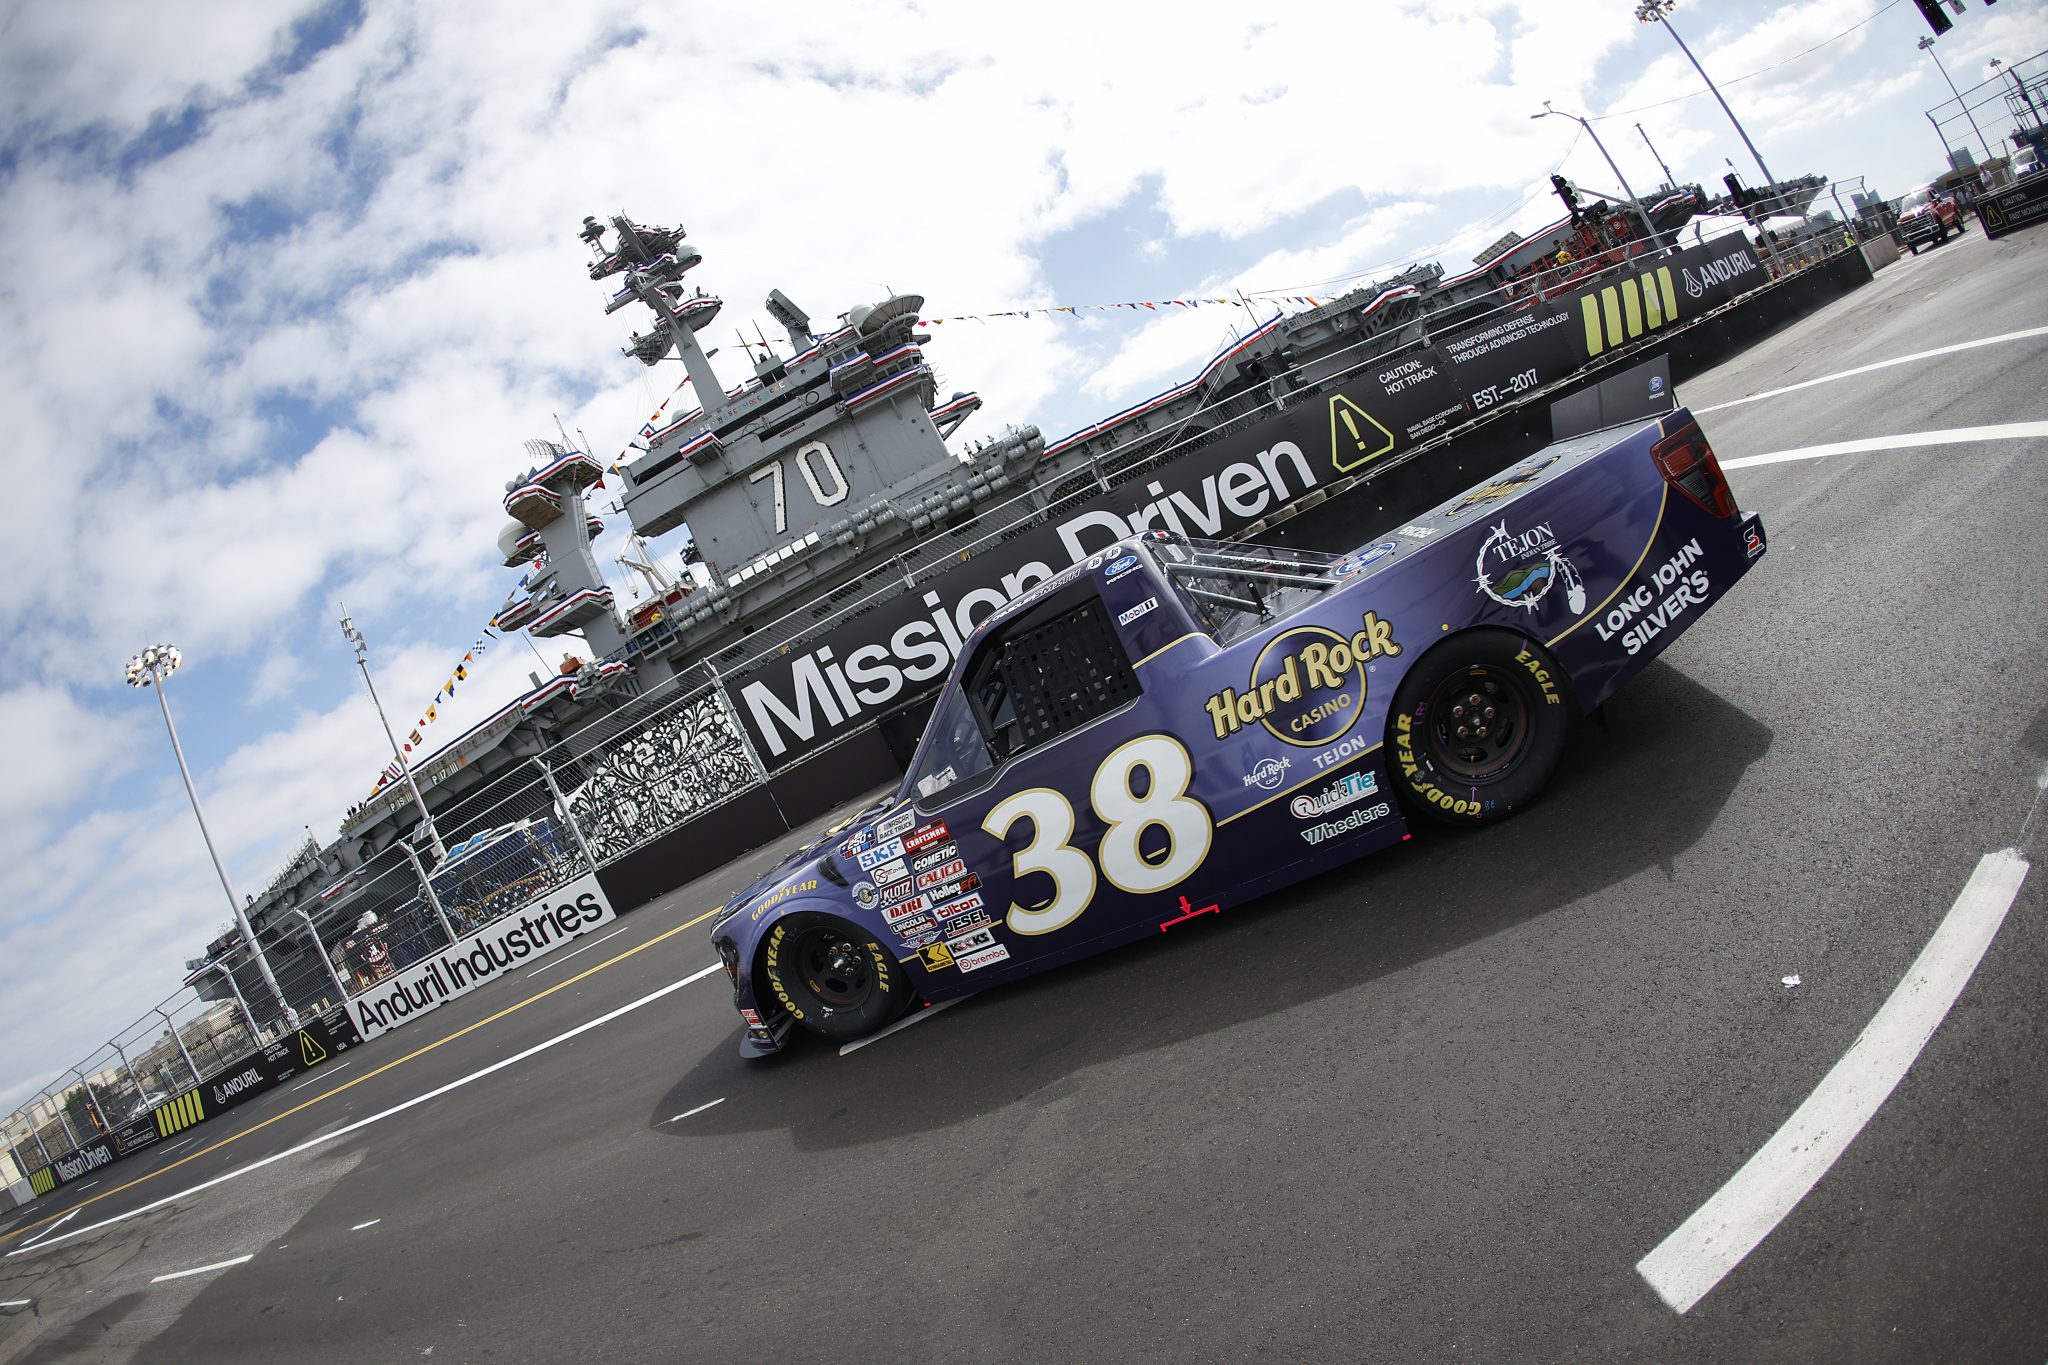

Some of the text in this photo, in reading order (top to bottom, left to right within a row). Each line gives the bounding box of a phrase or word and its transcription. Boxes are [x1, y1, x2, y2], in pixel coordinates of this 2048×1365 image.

[2008, 210, 2021, 221] FAST
[2021, 203, 2041, 217] MOVING
[1699, 250, 1757, 288] ANDURIL
[1446, 314, 1535, 354] TRANSFORMING DEFENSE
[1452, 312, 1569, 364] THROUGH ADVANCED TECHNOLOGY
[1379, 360, 1423, 384] CAUTION:
[1384, 366, 1438, 396] HOT TRACK
[1406, 403, 1463, 433] NAVAL BASE CORONADO
[1409, 430, 1421, 440] SAN
[749, 441, 850, 535] 70
[1492, 521, 1554, 562] TEJON
[1520, 539, 1558, 560] INDIAN TRIBE
[1106, 564, 1144, 585] RACING
[1112, 558, 1131, 573] Ford
[741, 440, 1317, 757] Mission Driven
[1594, 537, 1704, 642] LONG JOHN
[1120, 605, 1145, 624] Mobil
[1621, 570, 1710, 656] SILVER'S
[1204, 610, 1402, 740] Hard Rock
[1514, 649, 1560, 705] EAGLE
[1291, 692, 1352, 733] CASINO
[1312, 735, 1366, 769] TEJON
[1397, 713, 1481, 815] GOODYEAR
[1243, 756, 1291, 787] Hard Rock
[1265, 775, 1279, 786] CAFE
[880, 829, 895, 839] RACE
[894, 820, 913, 833] TRUCK
[887, 813, 910, 827] NASCAR
[980, 734, 1213, 935] 38
[1301, 802, 1389, 846] Wheelers
[906, 826, 946, 848] CRAFTSMAN
[861, 840, 901, 868] SKF
[914, 844, 956, 871] COMETIC
[917, 861, 963, 888] CALICO
[752, 879, 818, 921] GOODYEAR
[883, 881, 911, 900] KLOTZ
[931, 883, 961, 902] Holley
[937, 897, 980, 918] tilton
[945, 909, 988, 933] JESEL
[893, 915, 925, 933] LINCOLN
[903, 922, 933, 936] WELDERS
[950, 932, 990, 953] KOOKS
[971, 949, 1006, 966] brembo
[357, 892, 603, 1035] Anduril Industries
[767, 924, 805, 1020] GOODYEAR
[866, 942, 890, 993] EAGLE
[336, 1042, 348, 1051] USA
[223, 1067, 264, 1098] ANDURIL
[55, 1144, 113, 1182] Mission Driven
